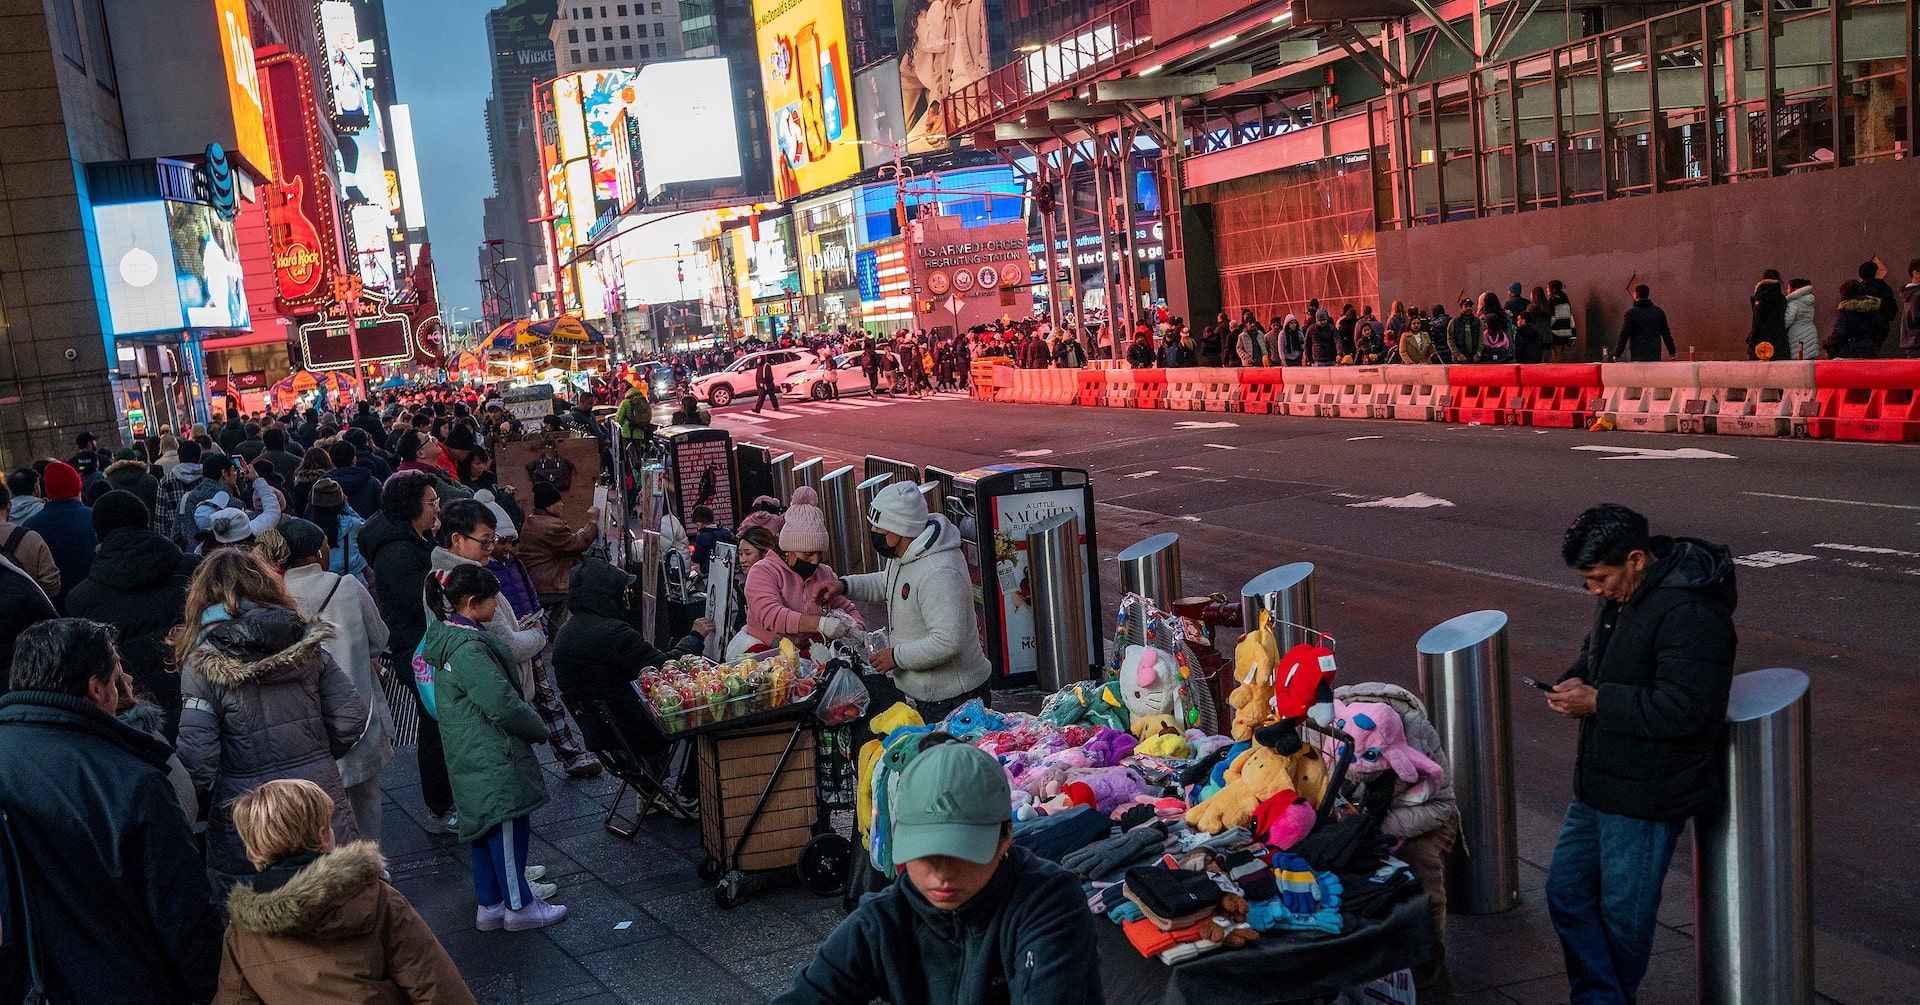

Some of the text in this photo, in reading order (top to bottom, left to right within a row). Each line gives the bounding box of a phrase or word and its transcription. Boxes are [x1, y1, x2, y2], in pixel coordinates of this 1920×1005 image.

[517, 49, 554, 65] WICKE
[939, 242, 979, 257] ARMED
[981, 239, 1024, 252] FORCES
[277, 249, 320, 269] Hard Rock
[807, 247, 846, 272] OLD NAVY
[925, 251, 1021, 268] RECRUITING STATION
[1033, 500, 1056, 509] LITTLE
[1013, 523, 1027, 531] BUT
